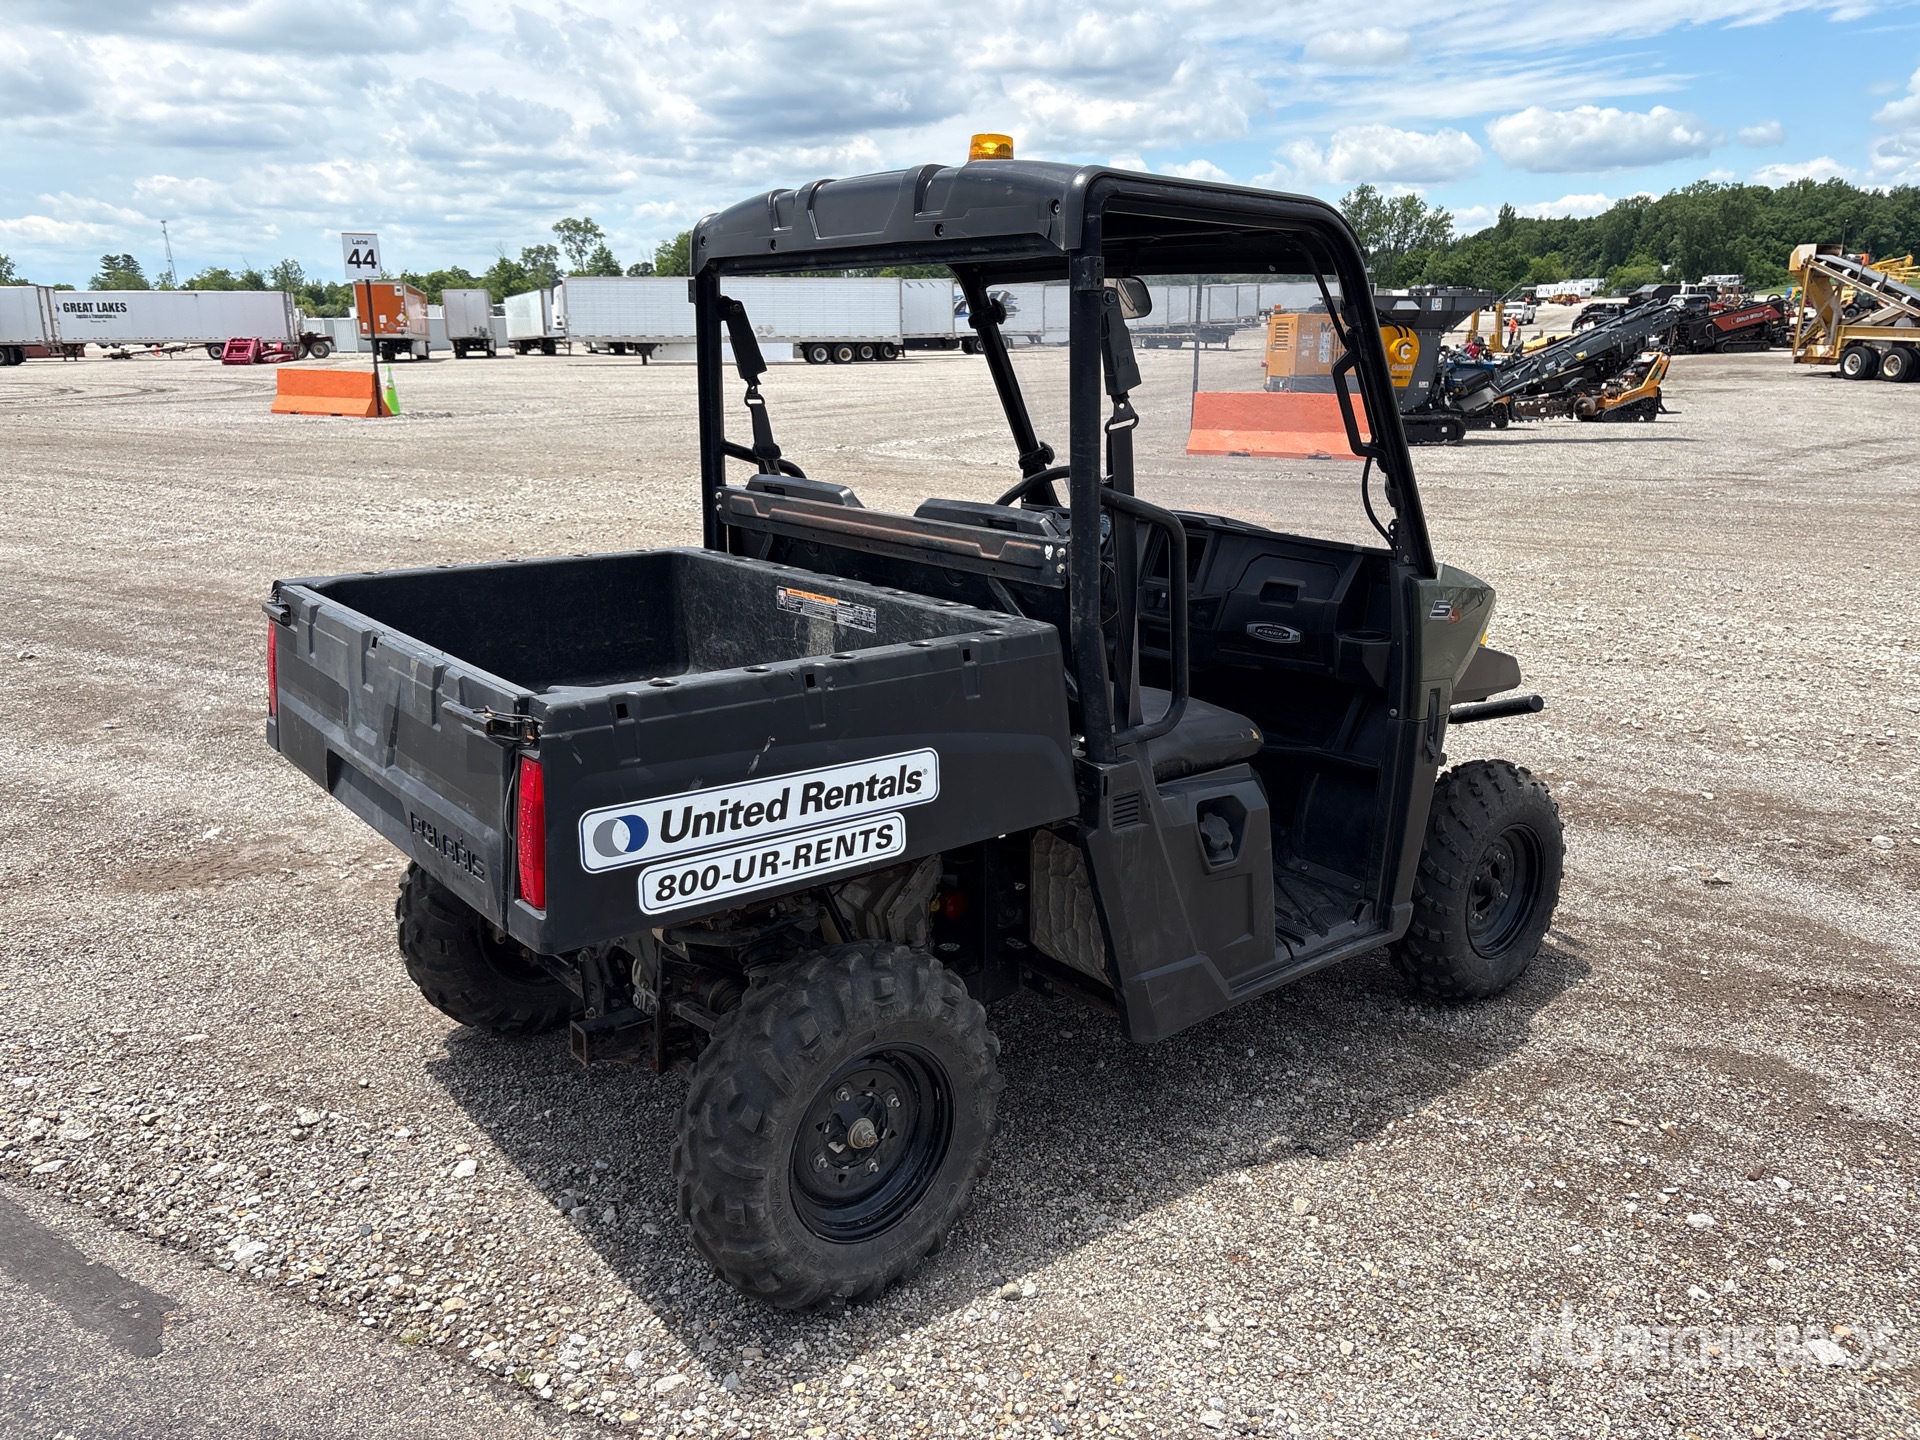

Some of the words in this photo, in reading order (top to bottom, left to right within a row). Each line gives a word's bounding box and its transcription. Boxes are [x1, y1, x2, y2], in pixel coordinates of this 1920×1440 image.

[351, 238, 369, 246] Lane
[347, 248, 378, 270] 44
[62, 302, 94, 313] GREAT
[96, 302, 128, 313] LAKES
[1256, 628, 1290, 638] RANGER
[659, 787, 792, 845] United
[799, 764, 924, 816] Rentals
[410, 811, 486, 884] POLARIS
[654, 823, 895, 902] 800-UR-RENTS
